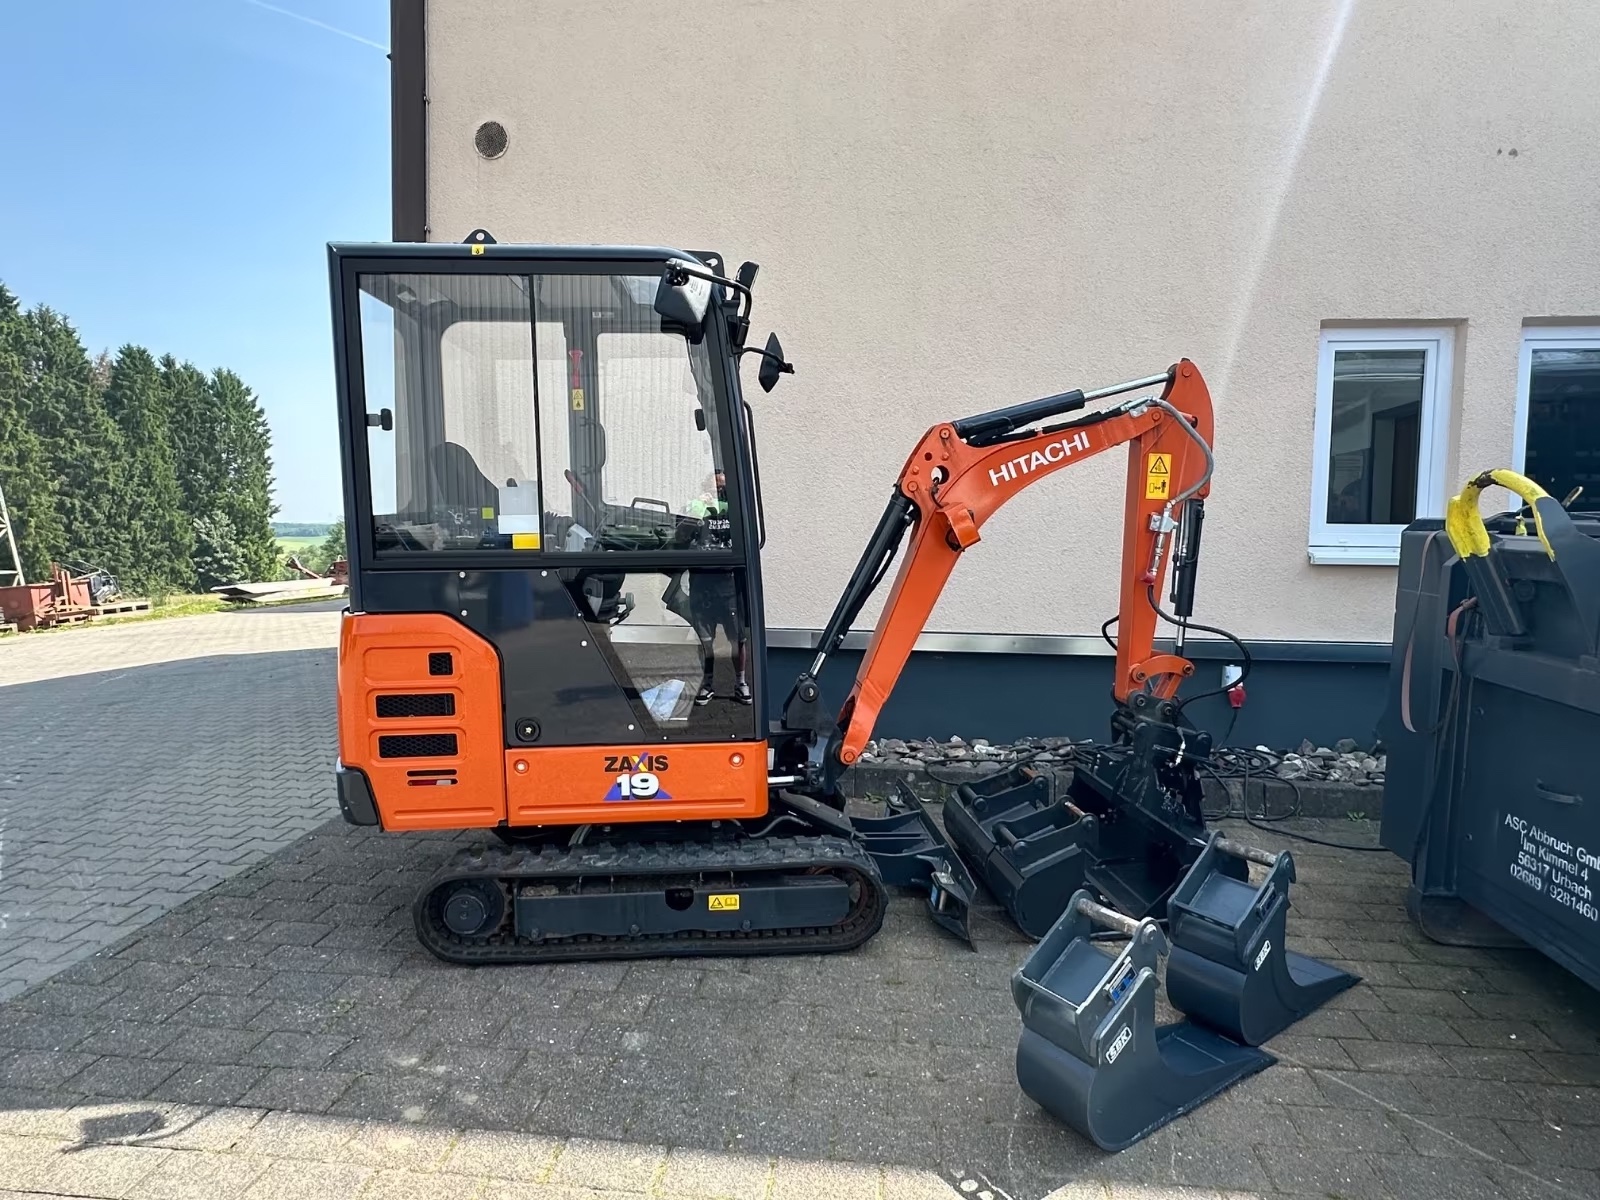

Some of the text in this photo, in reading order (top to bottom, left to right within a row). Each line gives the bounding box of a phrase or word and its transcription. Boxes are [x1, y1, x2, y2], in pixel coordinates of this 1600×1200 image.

[988, 430, 1091, 487] HITACHI
[604, 751, 669, 773] ZAXIS
[616, 772, 660, 800] 19
[1504, 813, 1528, 834] ASC
[1529, 825, 1574, 857] Abbruch
[1518, 851, 1592, 902] 56317 Urbach
[1523, 837, 1589, 882] Im Kimmel 4
[1510, 863, 1542, 891] 02689
[1549, 884, 1599, 922] 9281460
